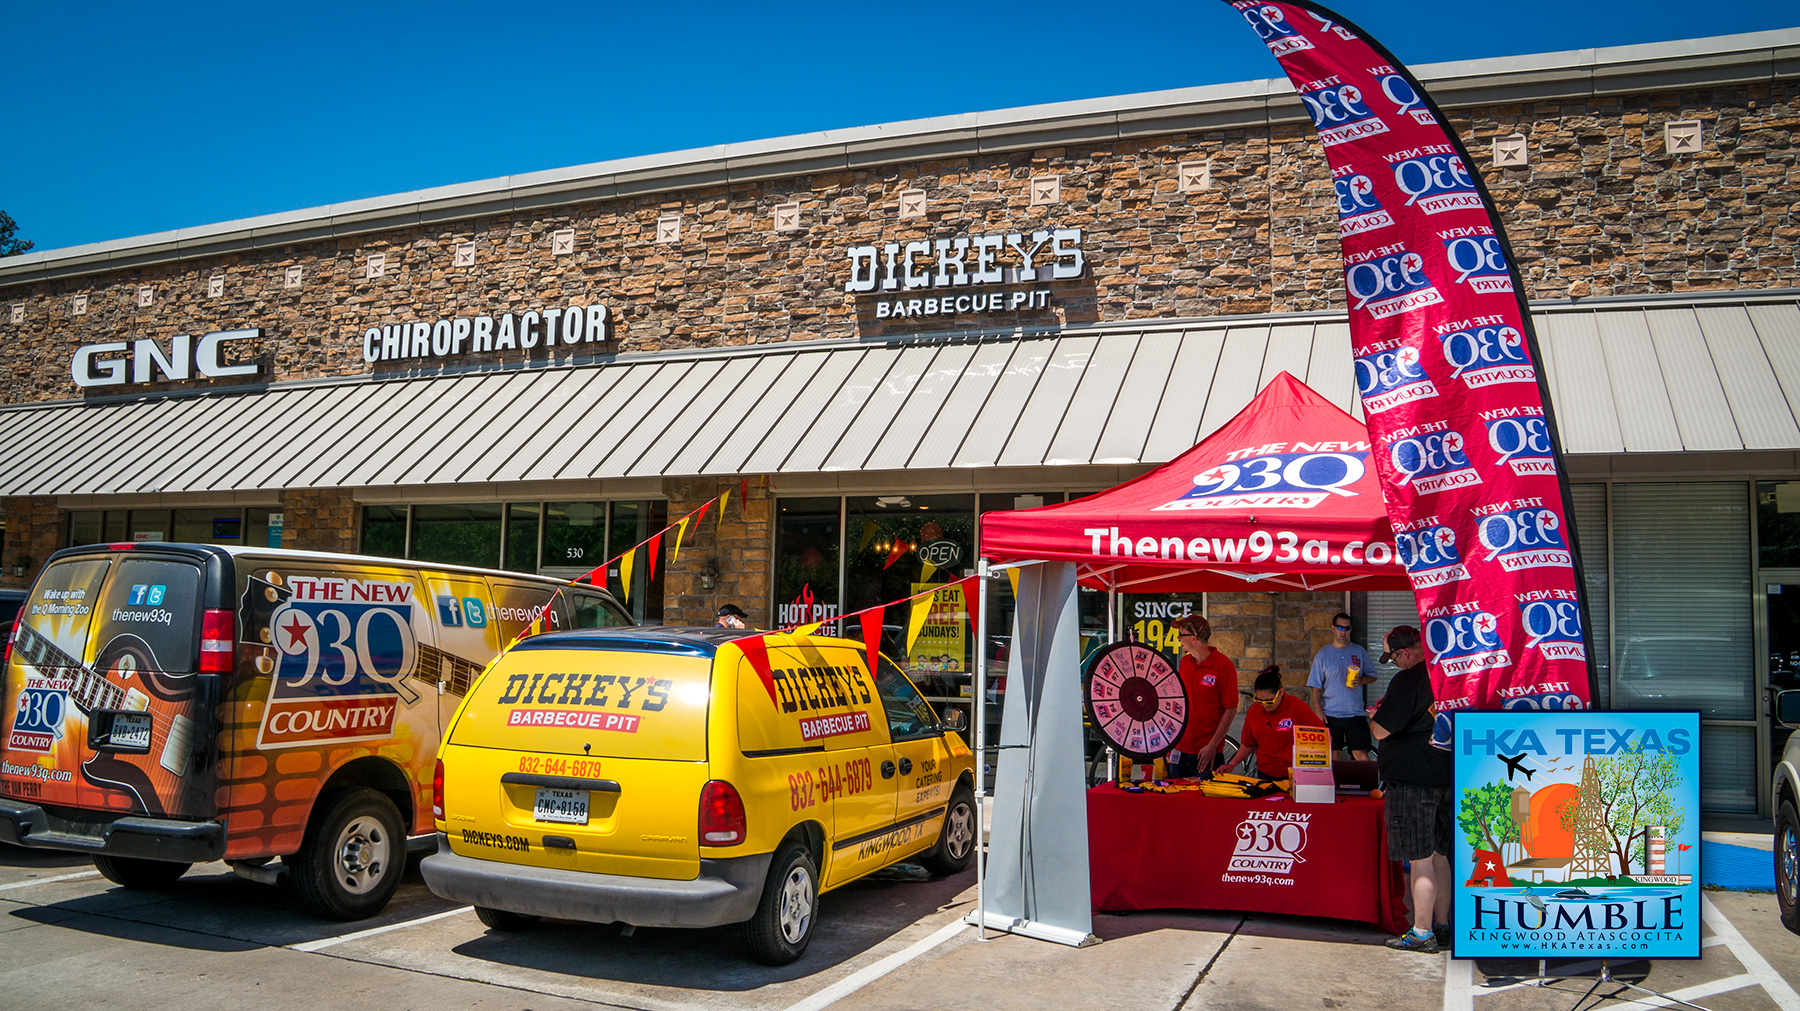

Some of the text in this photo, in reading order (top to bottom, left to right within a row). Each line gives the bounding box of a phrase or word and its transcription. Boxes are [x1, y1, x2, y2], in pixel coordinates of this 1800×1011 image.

[876, 291, 1050, 318] BARBECUE PIT
[364, 304, 607, 362] CHIROPRACTOR
[72, 328, 261, 387] GNC
[1226, 440, 1371, 462] THE NEW
[1192, 453, 1366, 497] 93Q
[1162, 494, 1321, 508] COUNTRY
[566, 548, 584, 559] 530
[919, 546, 960, 562] OPEN
[43, 589, 86, 601] Wake up with
[292, 581, 410, 602] THE NEW
[943, 590, 960, 602] EAT
[31, 604, 41, 614] the
[47, 604, 74, 616] Morning
[74, 604, 89, 615] Zoo
[112, 609, 172, 626] thenew93q
[779, 604, 838, 624] HOT PIT
[928, 603, 960, 626] REE
[1134, 602, 1193, 618] SINCE
[1134, 619, 1182, 655] 194
[275, 607, 419, 704] 93Q
[28, 679, 71, 690] THE NEW
[17, 691, 64, 740] 93Q
[269, 706, 394, 735] COUNTRY
[510, 711, 637, 730] BARBECUE PIT
[802, 713, 868, 738] BARBECUE PIT
[12, 734, 52, 748] COUNTRY
[1297, 733, 1324, 742] $500
[2, 759, 72, 783] thenew93q.com
[519, 756, 602, 778] 832-644-6879
[921, 758, 936, 772] YOUR
[789, 757, 872, 812] 832-644-6879
[916, 772, 942, 789] CATERING
[1248, 811, 1312, 822] THE NEW
[914, 822, 924, 838] TX
[462, 829, 530, 852] DICKEYS.COM
[1236, 822, 1308, 864] 93Q
[1232, 860, 1291, 870] COUNTRY
[1222, 873, 1294, 886] thenew93q.com
